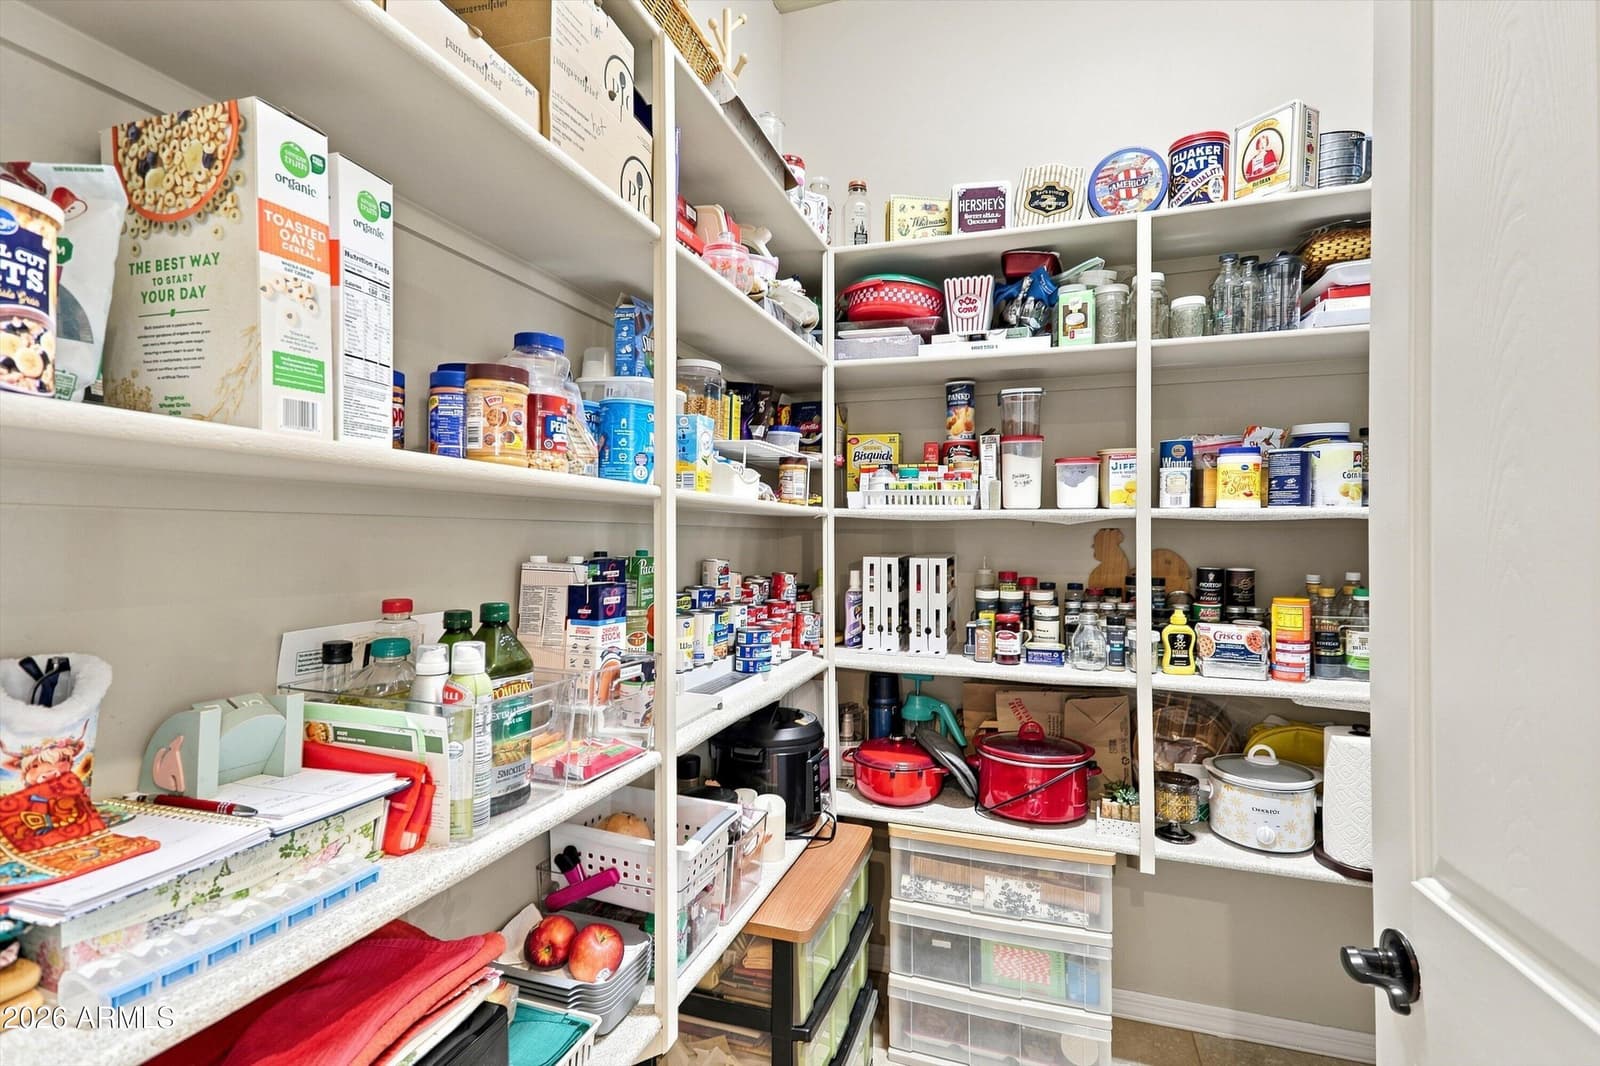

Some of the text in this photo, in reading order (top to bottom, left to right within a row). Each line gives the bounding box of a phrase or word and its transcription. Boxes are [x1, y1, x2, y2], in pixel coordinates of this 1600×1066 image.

[1172, 145, 1221, 165] QUAKER
[1173, 155, 1219, 176] OATS
[274, 172, 318, 199] organic
[959, 196, 1005, 213] HERSHEY'S
[263, 208, 328, 243] TOASTED
[353, 218, 385, 241] organic
[280, 228, 316, 252] OATS
[15, 248, 47, 271] CUT
[281, 242, 316, 261] CEREAL
[128, 252, 220, 276] THE BEST WAY
[152, 273, 193, 287] TO START
[141, 285, 207, 305] YOUR DAY
[853, 450, 893, 464] Bisquick
[1213, 630, 1243, 641] Crisco
